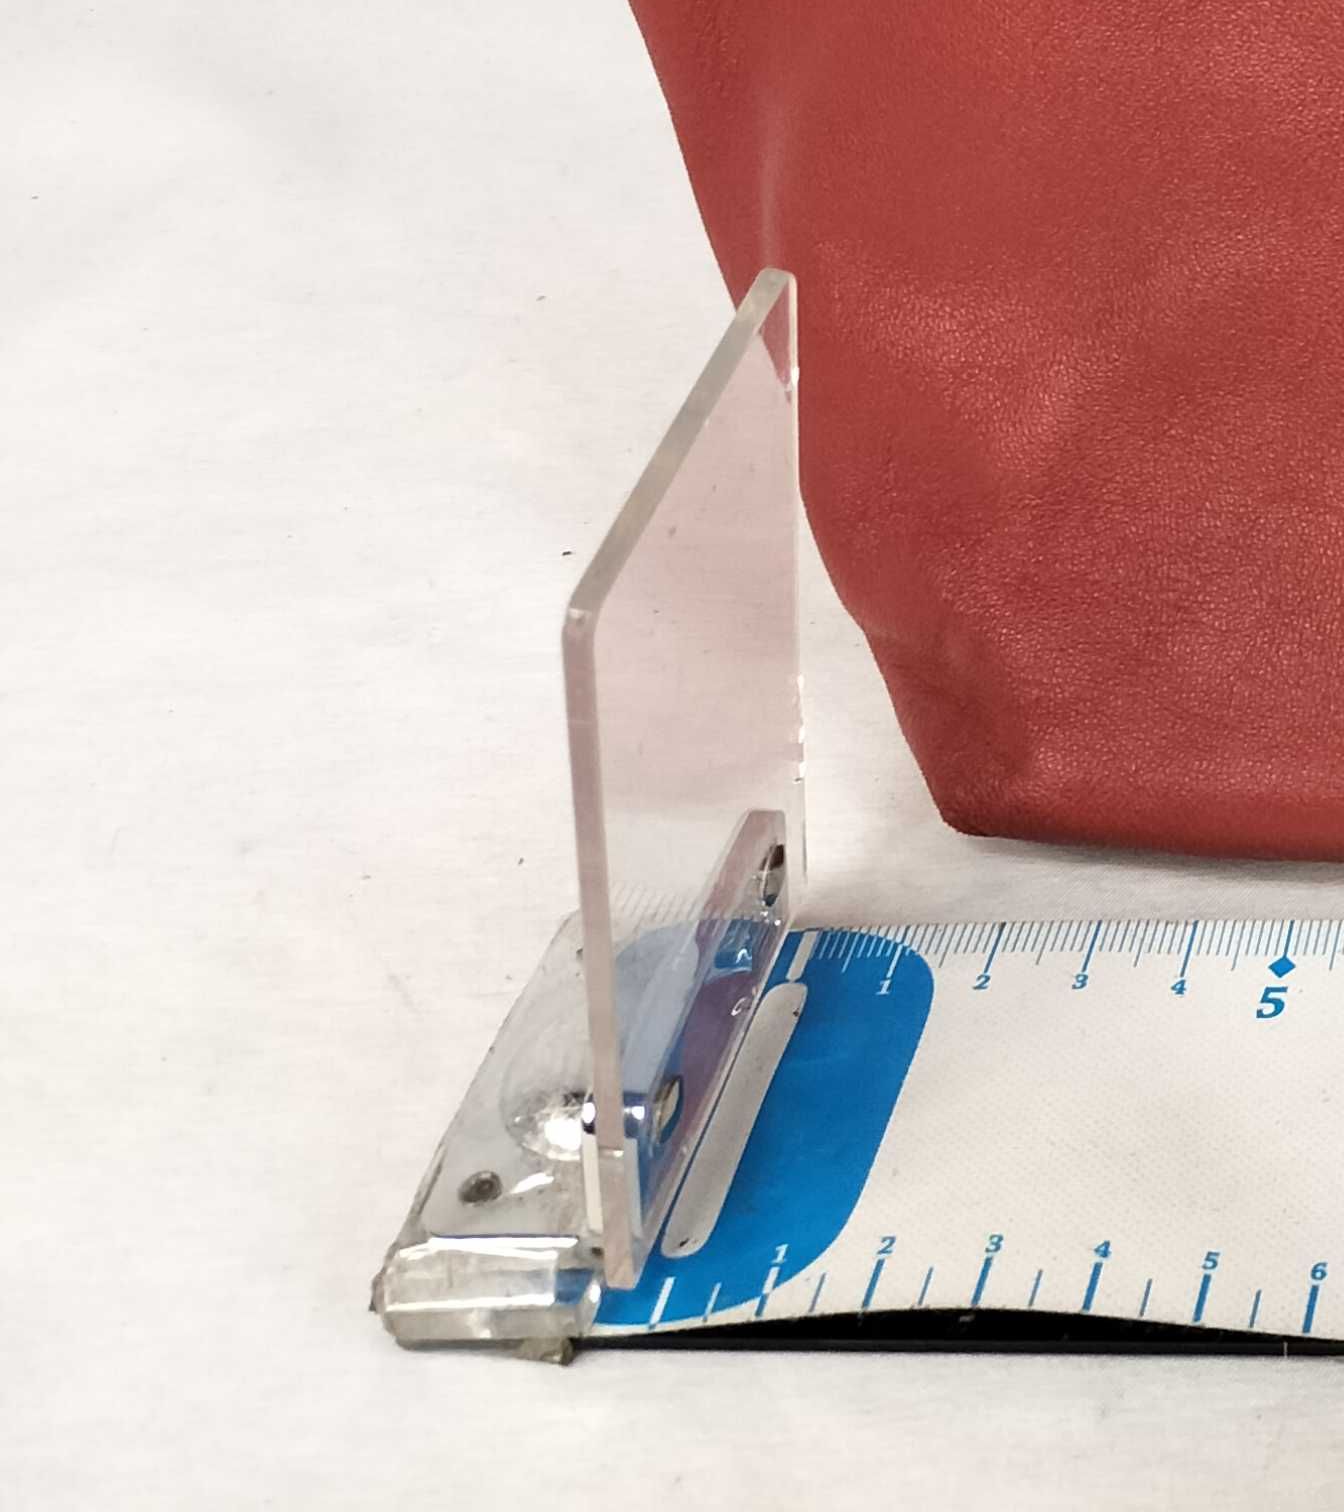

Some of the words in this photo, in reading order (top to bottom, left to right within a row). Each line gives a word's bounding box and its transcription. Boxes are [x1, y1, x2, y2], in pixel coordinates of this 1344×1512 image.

[875, 978, 893, 996] 1
[972, 974, 991, 991] 2
[1071, 973, 1089, 990] 3
[1170, 979, 1188, 996] 4
[1256, 985, 1289, 1019] 5
[770, 1243, 789, 1264] 1
[875, 1235, 896, 1255] 2
[984, 1234, 1005, 1254] 3
[1093, 1239, 1112, 1259] 4
[1201, 1251, 1221, 1270] 5
[1310, 1261, 1328, 1281] 6
